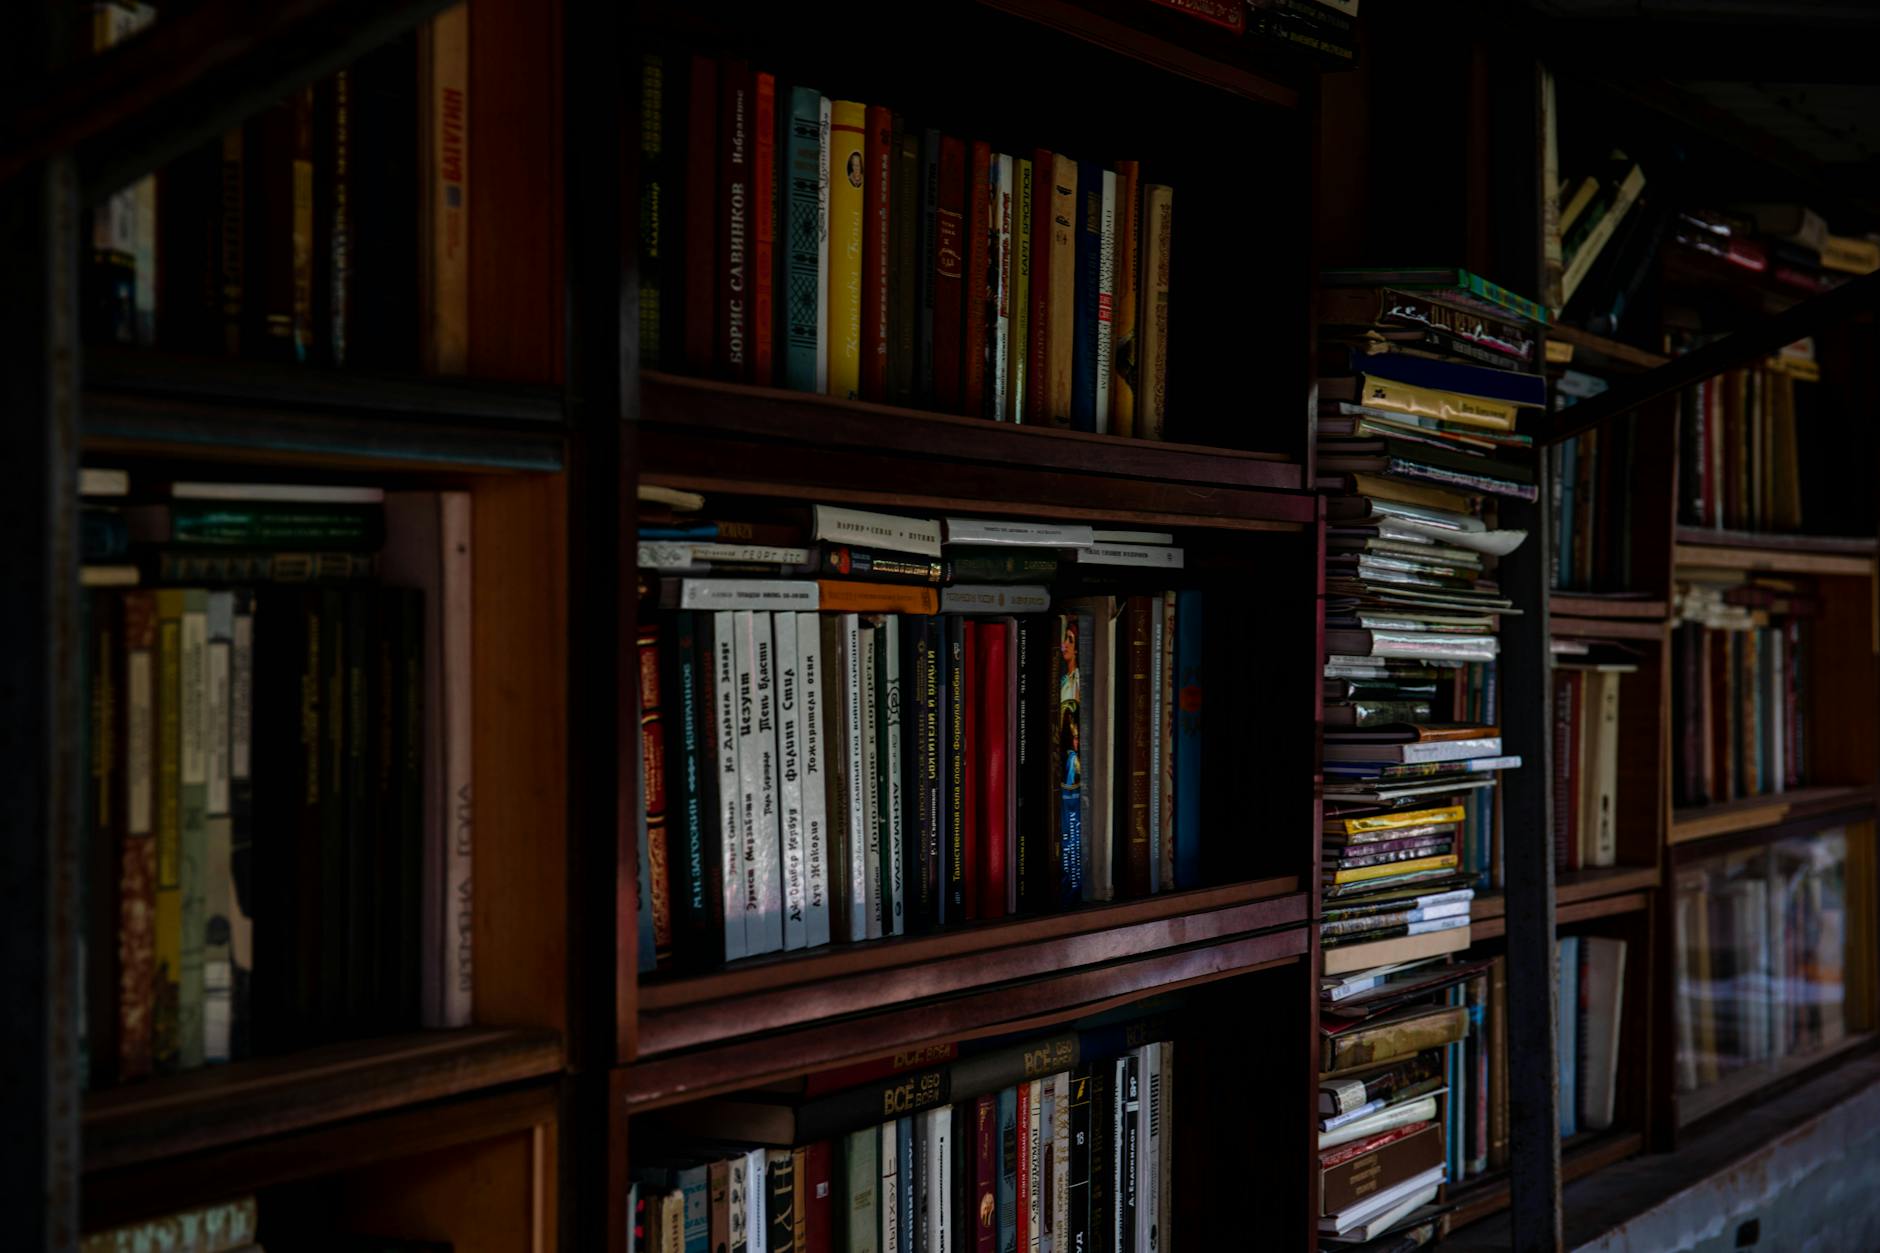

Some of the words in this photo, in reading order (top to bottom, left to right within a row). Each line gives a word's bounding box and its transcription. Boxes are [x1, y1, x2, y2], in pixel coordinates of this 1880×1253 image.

[733, 89, 745, 164] Избранное
[1022, 166, 1030, 235] БРЮЛЛОВ
[730, 182, 744, 292] САВИНКОВ
[729, 297, 743, 364] БОРИС
[740, 671, 752, 737] Иезуит
[782, 668, 794, 711] Стил
[867, 642, 877, 729] портретам
[926, 649, 936, 696] ВЛАСТИ
[951, 667, 960, 702] любви
[683, 663, 696, 751] ИЗБРАННОЕ
[759, 694, 772, 733] Тень
[806, 691, 817, 775] Пожиратели
[952, 703, 961, 751] Формула
[785, 720, 798, 782] Филипп
[852, 735, 860, 756] ГОД
[926, 712, 937, 779] СВЯТИТЕЛИ
[853, 760, 861, 812] СЛАВНЫЙ
[868, 751, 879, 854] Дополнение
[953, 785, 961, 810] сила
[810, 820, 821, 879] Жаколио
[893, 782, 902, 892] AKHMATOVA
[952, 811, 961, 882] Таинственная
[1031, 1128, 1039, 1197] ВЕЛЬТМАН
[888, 1182, 897, 1251] РЫТХЭУ
